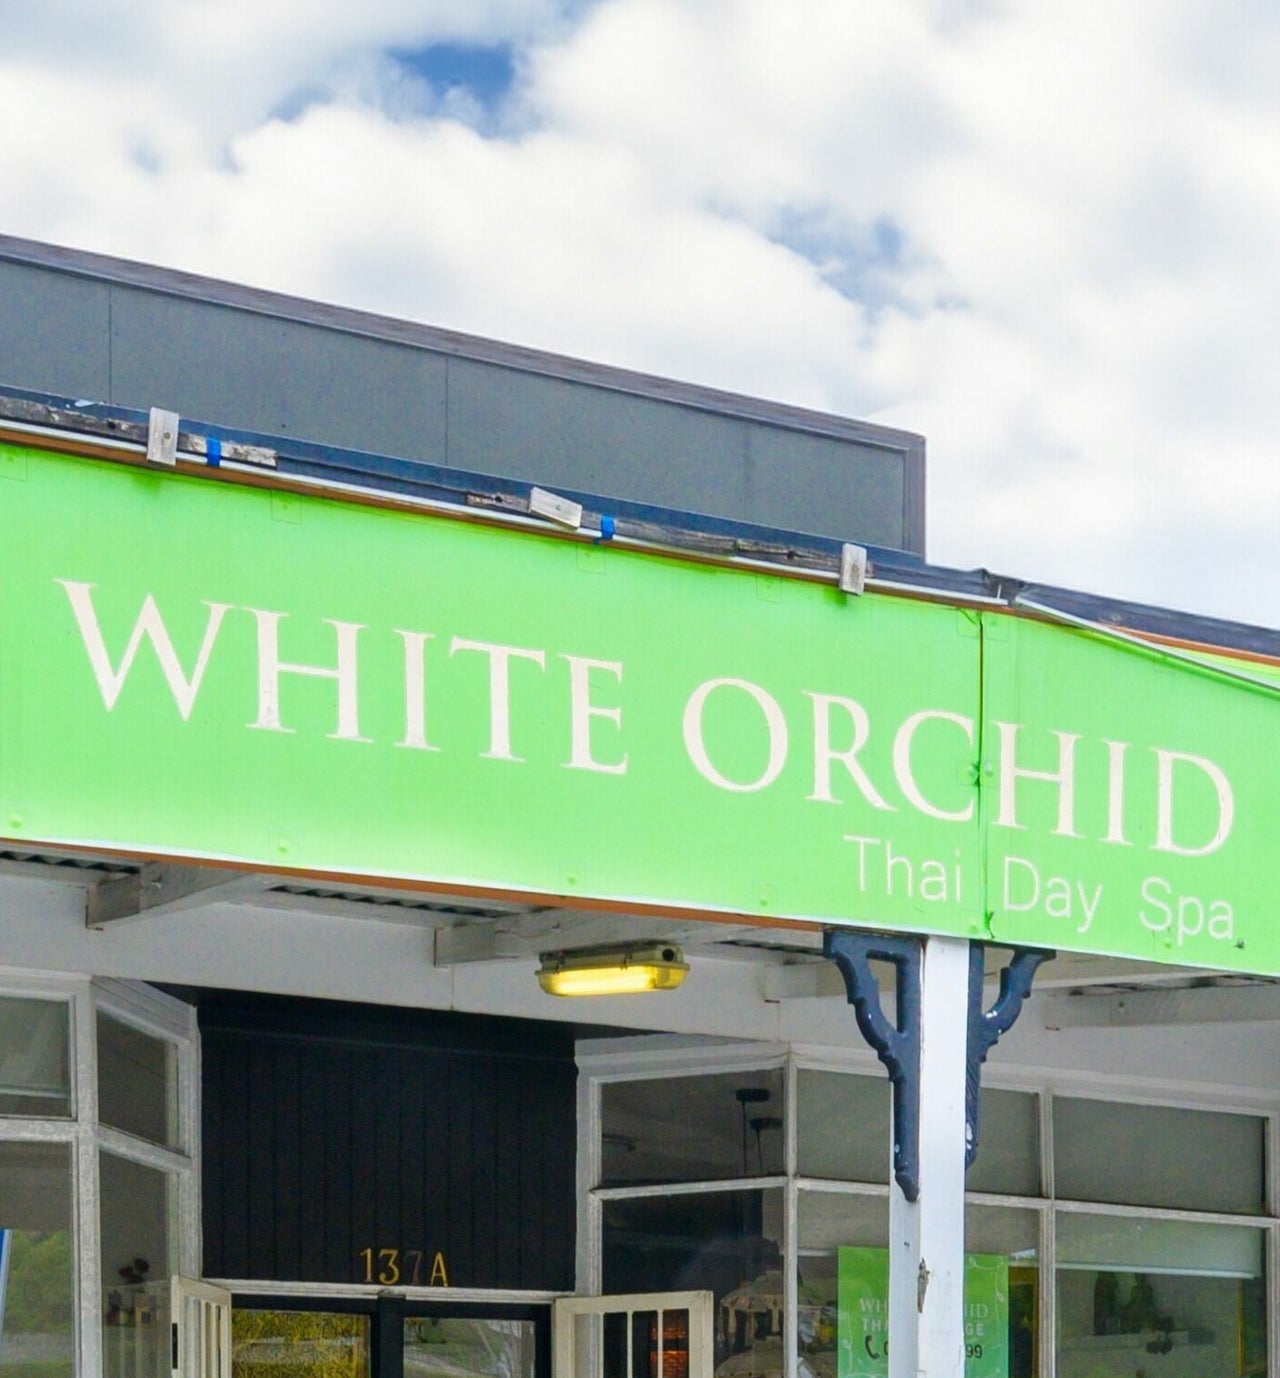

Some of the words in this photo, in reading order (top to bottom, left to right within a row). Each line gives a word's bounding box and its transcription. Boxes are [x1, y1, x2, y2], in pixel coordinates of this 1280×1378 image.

[53, 577, 629, 776] WHITE
[682, 677, 1235, 857] ORCHID
[842, 834, 962, 903] Thai
[1004, 856, 1103, 934] Day
[1138, 876, 1234, 946] Spa
[359, 1247, 448, 1288] 137A
